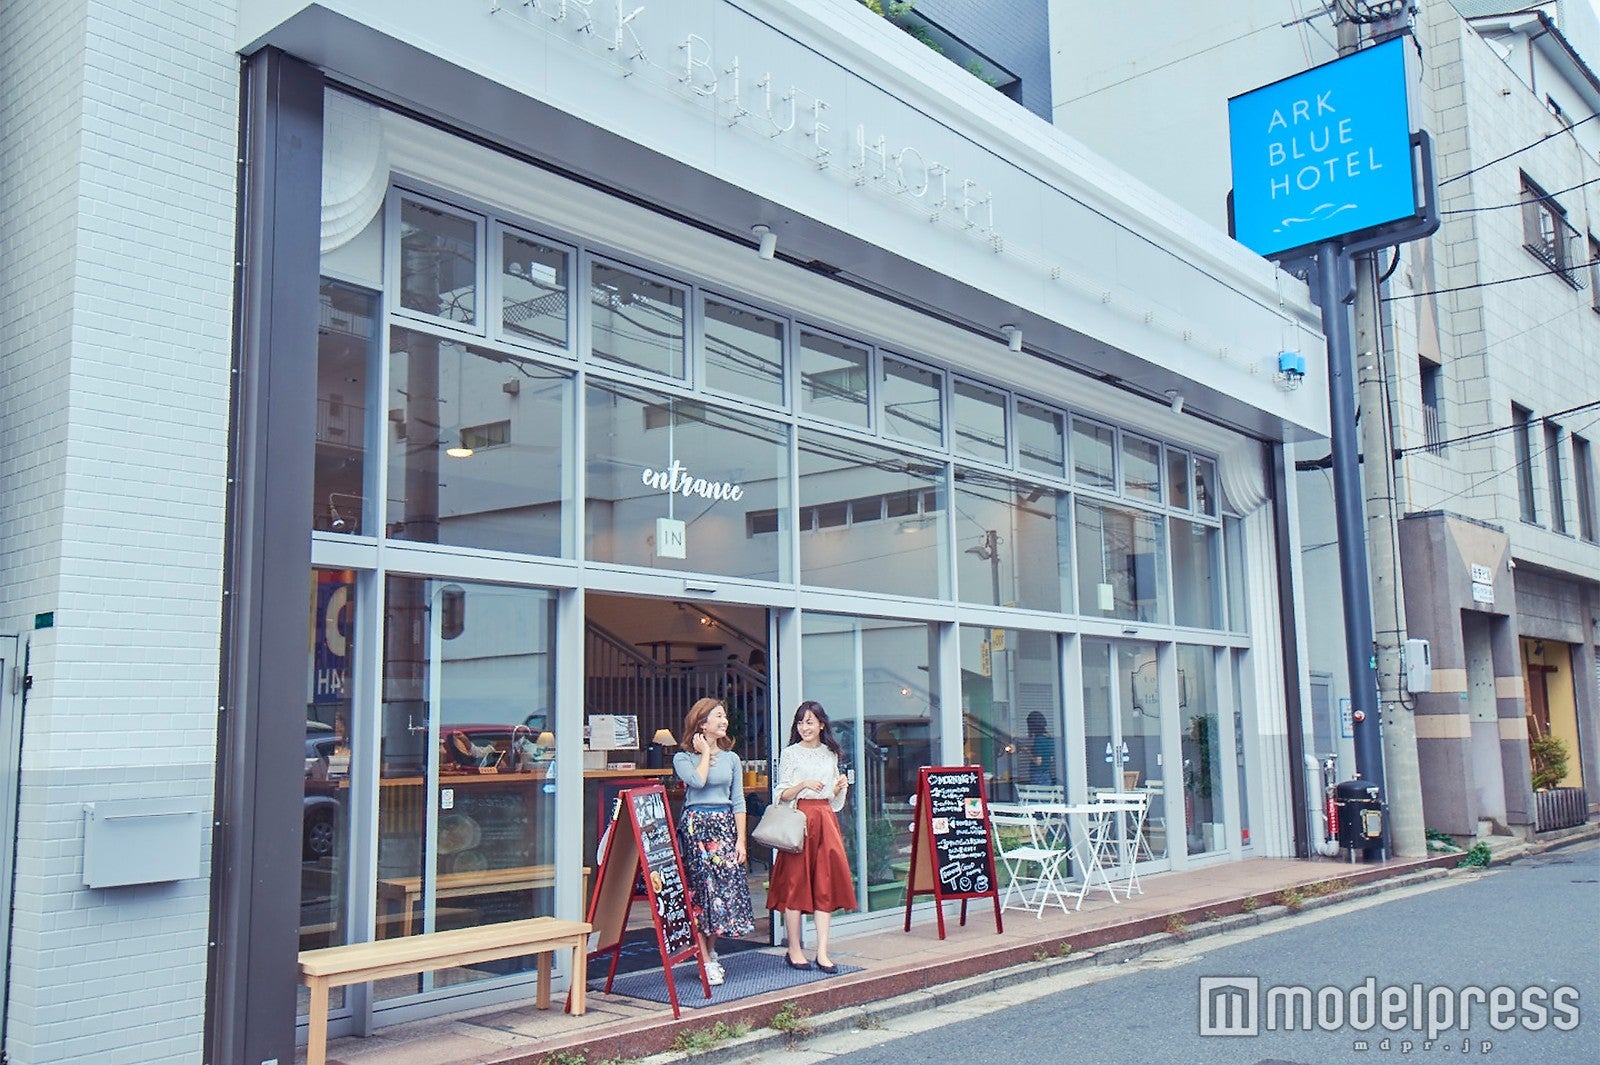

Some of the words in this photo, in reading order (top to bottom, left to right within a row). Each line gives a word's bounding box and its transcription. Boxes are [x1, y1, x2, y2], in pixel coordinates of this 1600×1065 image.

[686, 33, 831, 158] BLUE
[856, 124, 1000, 236] HOTEL
[1267, 90, 1336, 134] ARK
[1268, 118, 1353, 167] BLUE
[1270, 147, 1383, 200] HOTEL
[642, 459, 744, 501] entrance
[664, 531, 682, 546] IN
